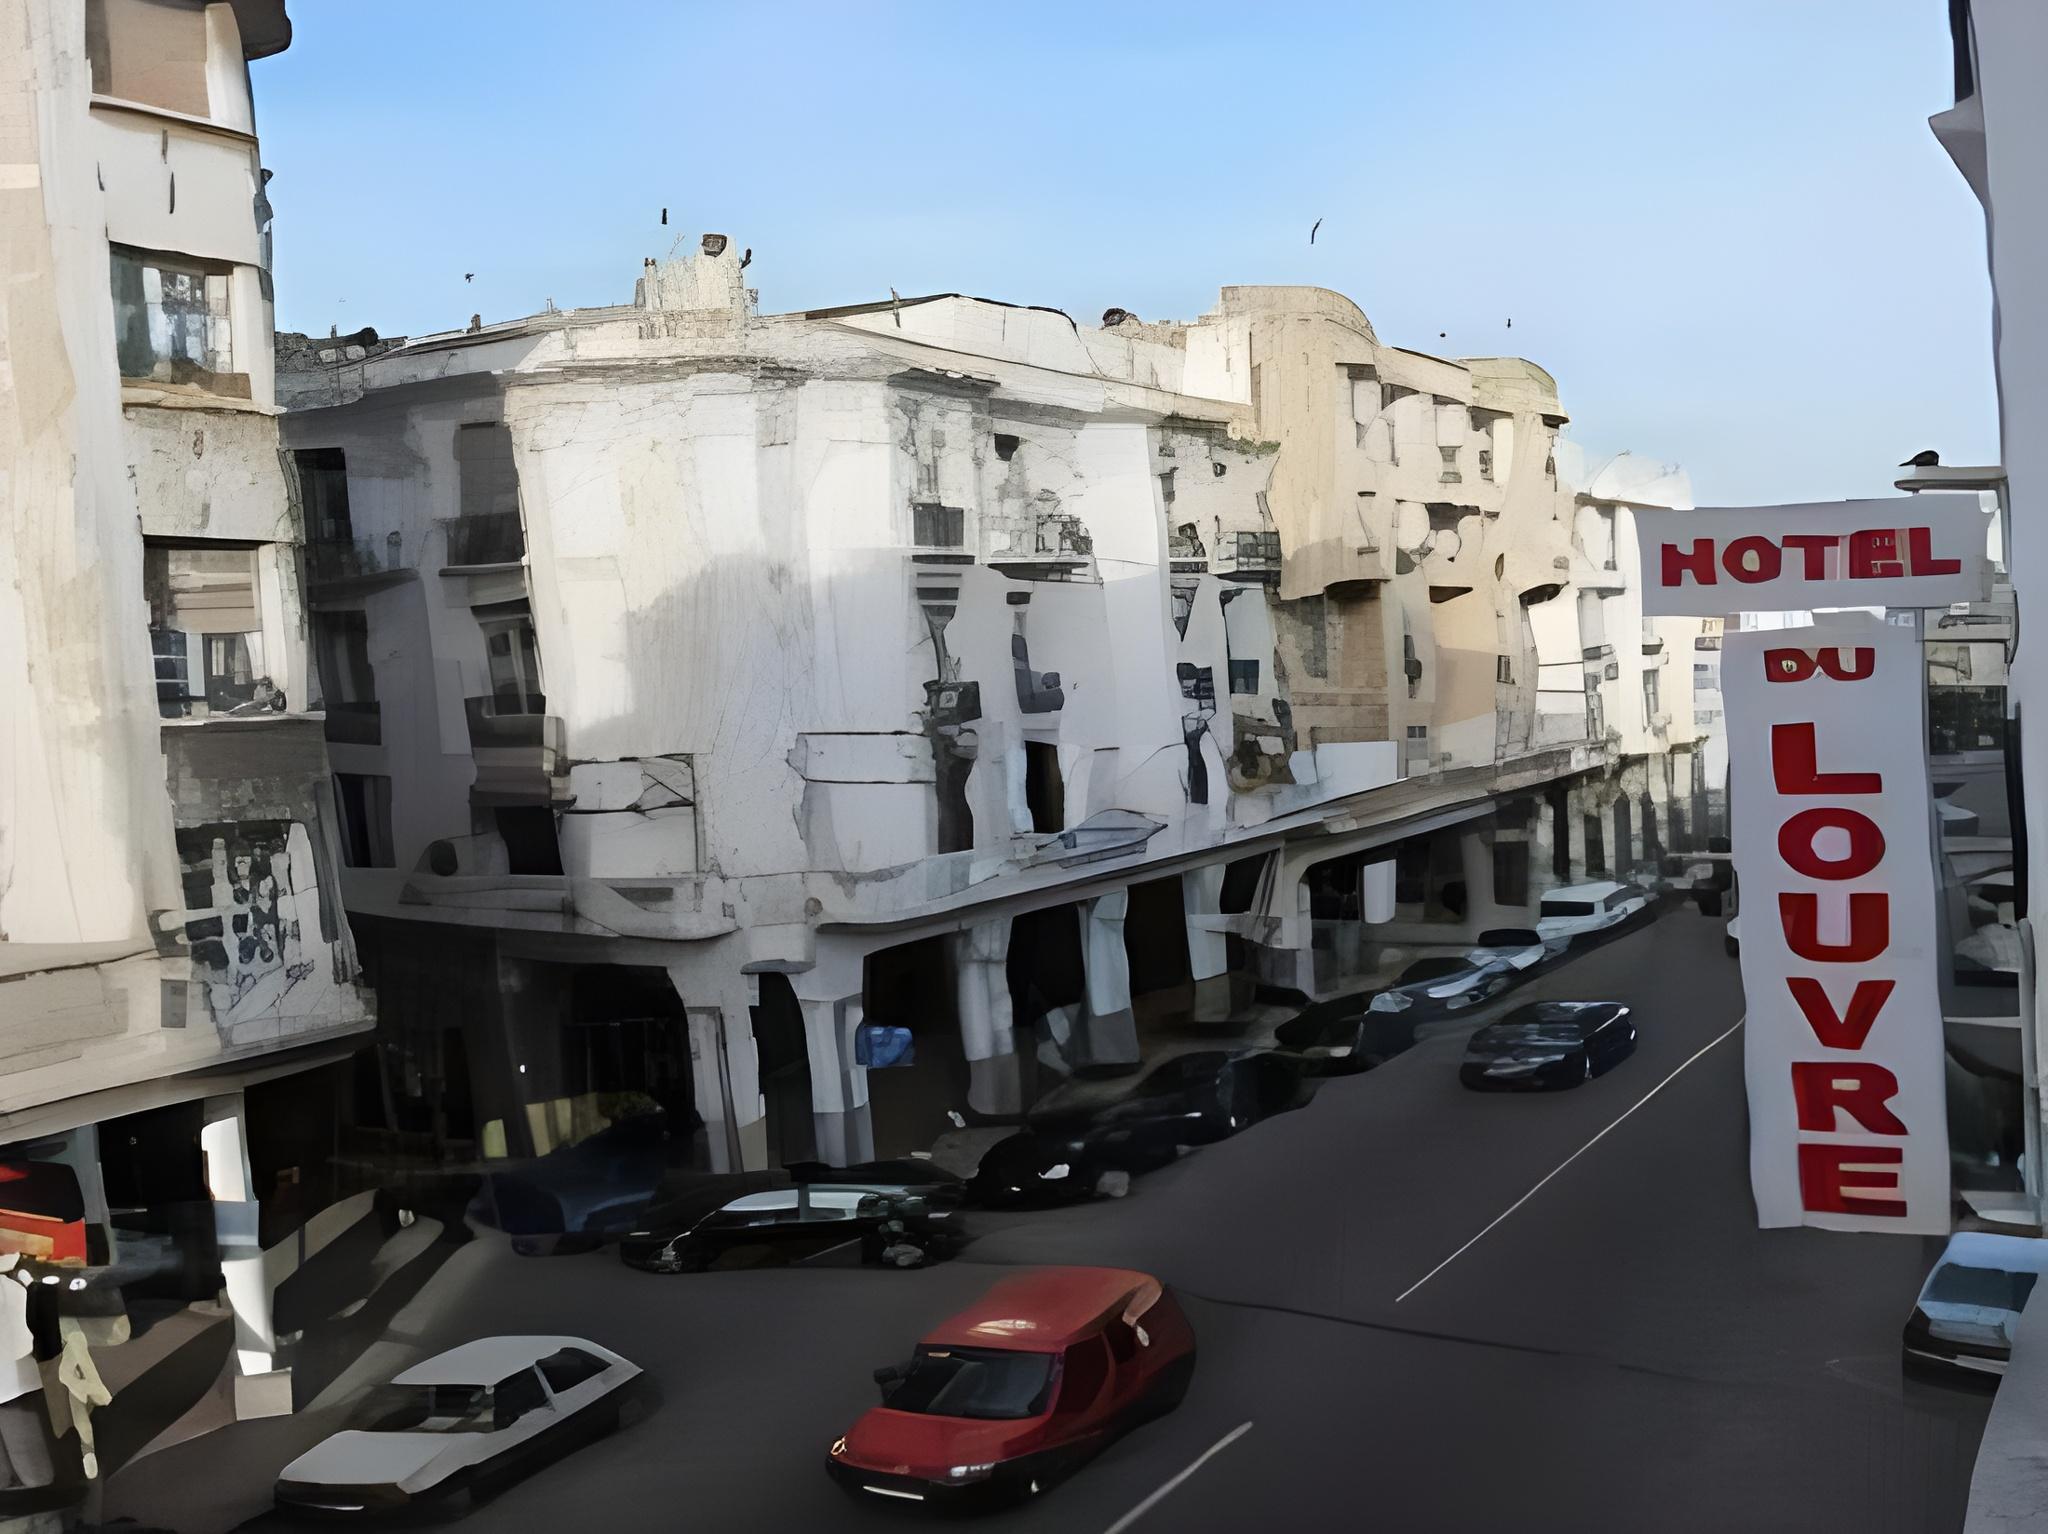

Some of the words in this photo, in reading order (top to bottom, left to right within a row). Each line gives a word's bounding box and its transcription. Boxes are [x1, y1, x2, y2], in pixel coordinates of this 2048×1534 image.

[1661, 527, 1961, 587] HOTEL
[1764, 647, 1875, 683] DU
[1771, 722, 1909, 1217] LOUVRE
